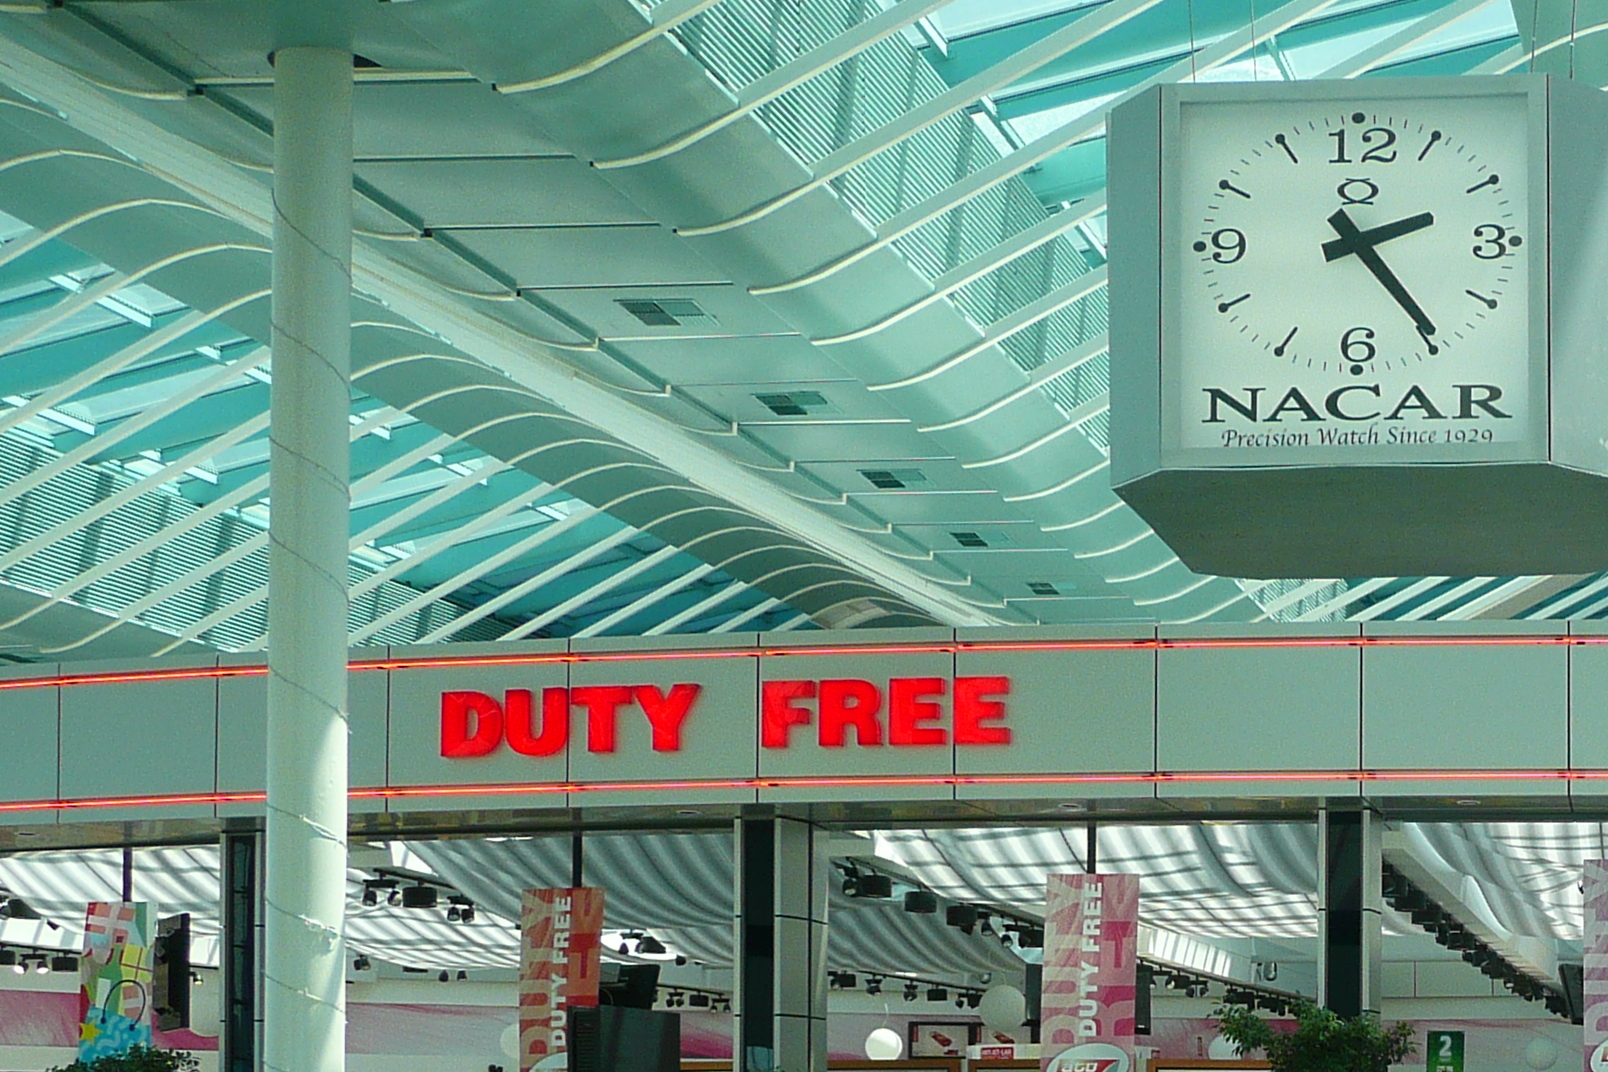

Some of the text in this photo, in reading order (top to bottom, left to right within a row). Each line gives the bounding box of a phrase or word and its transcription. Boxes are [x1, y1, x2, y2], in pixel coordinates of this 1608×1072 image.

[1328, 127, 1397, 164] 12
[1211, 228, 1247, 264] 9
[1472, 224, 1507, 259] 3
[1340, 327, 1376, 363] 6
[1201, 384, 1513, 423] NACAR
[1221, 422, 1493, 448] Precision Watch Since 1929
[440, 675, 1012, 759] DUTY FREE
[550, 896, 572, 1046] DUTY FREE
[1079, 882, 1103, 1037] DUTY FREE
[1439, 1035, 1452, 1057] 2
